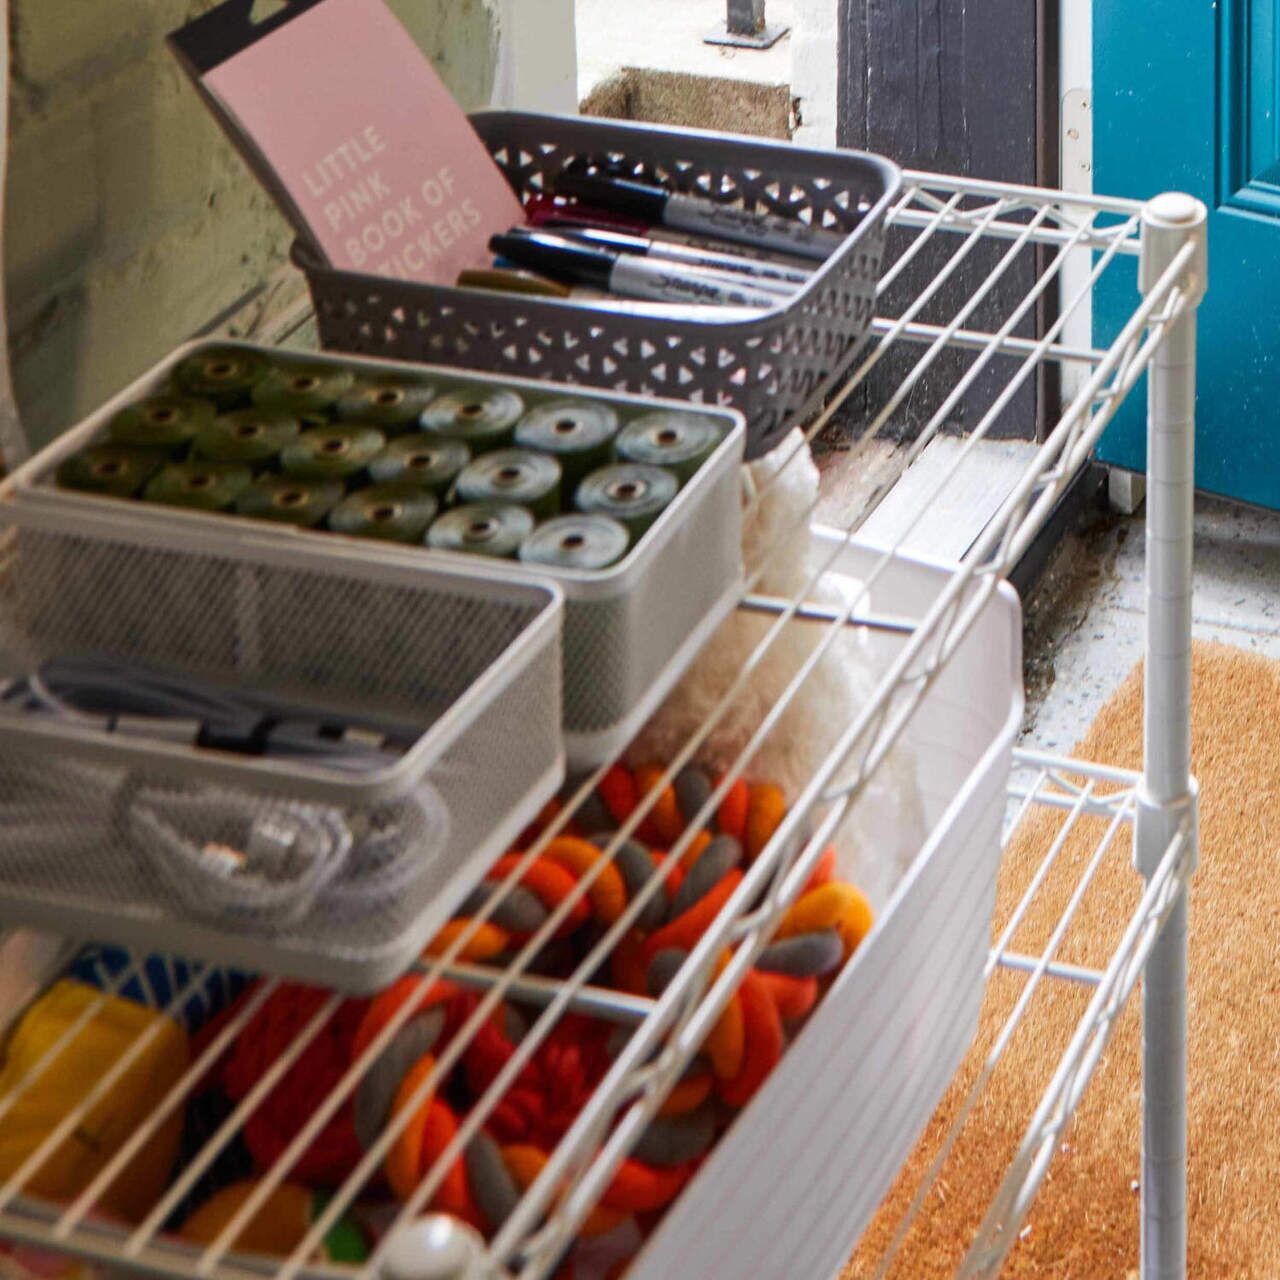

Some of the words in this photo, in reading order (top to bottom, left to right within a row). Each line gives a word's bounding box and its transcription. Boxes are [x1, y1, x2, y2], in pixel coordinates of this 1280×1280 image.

[301, 125, 386, 197] LITTLE
[323, 170, 391, 232] PINK
[344, 196, 422, 268] BOOK
[420, 166, 455, 208] OF
[375, 198, 481, 280] TICKERS
